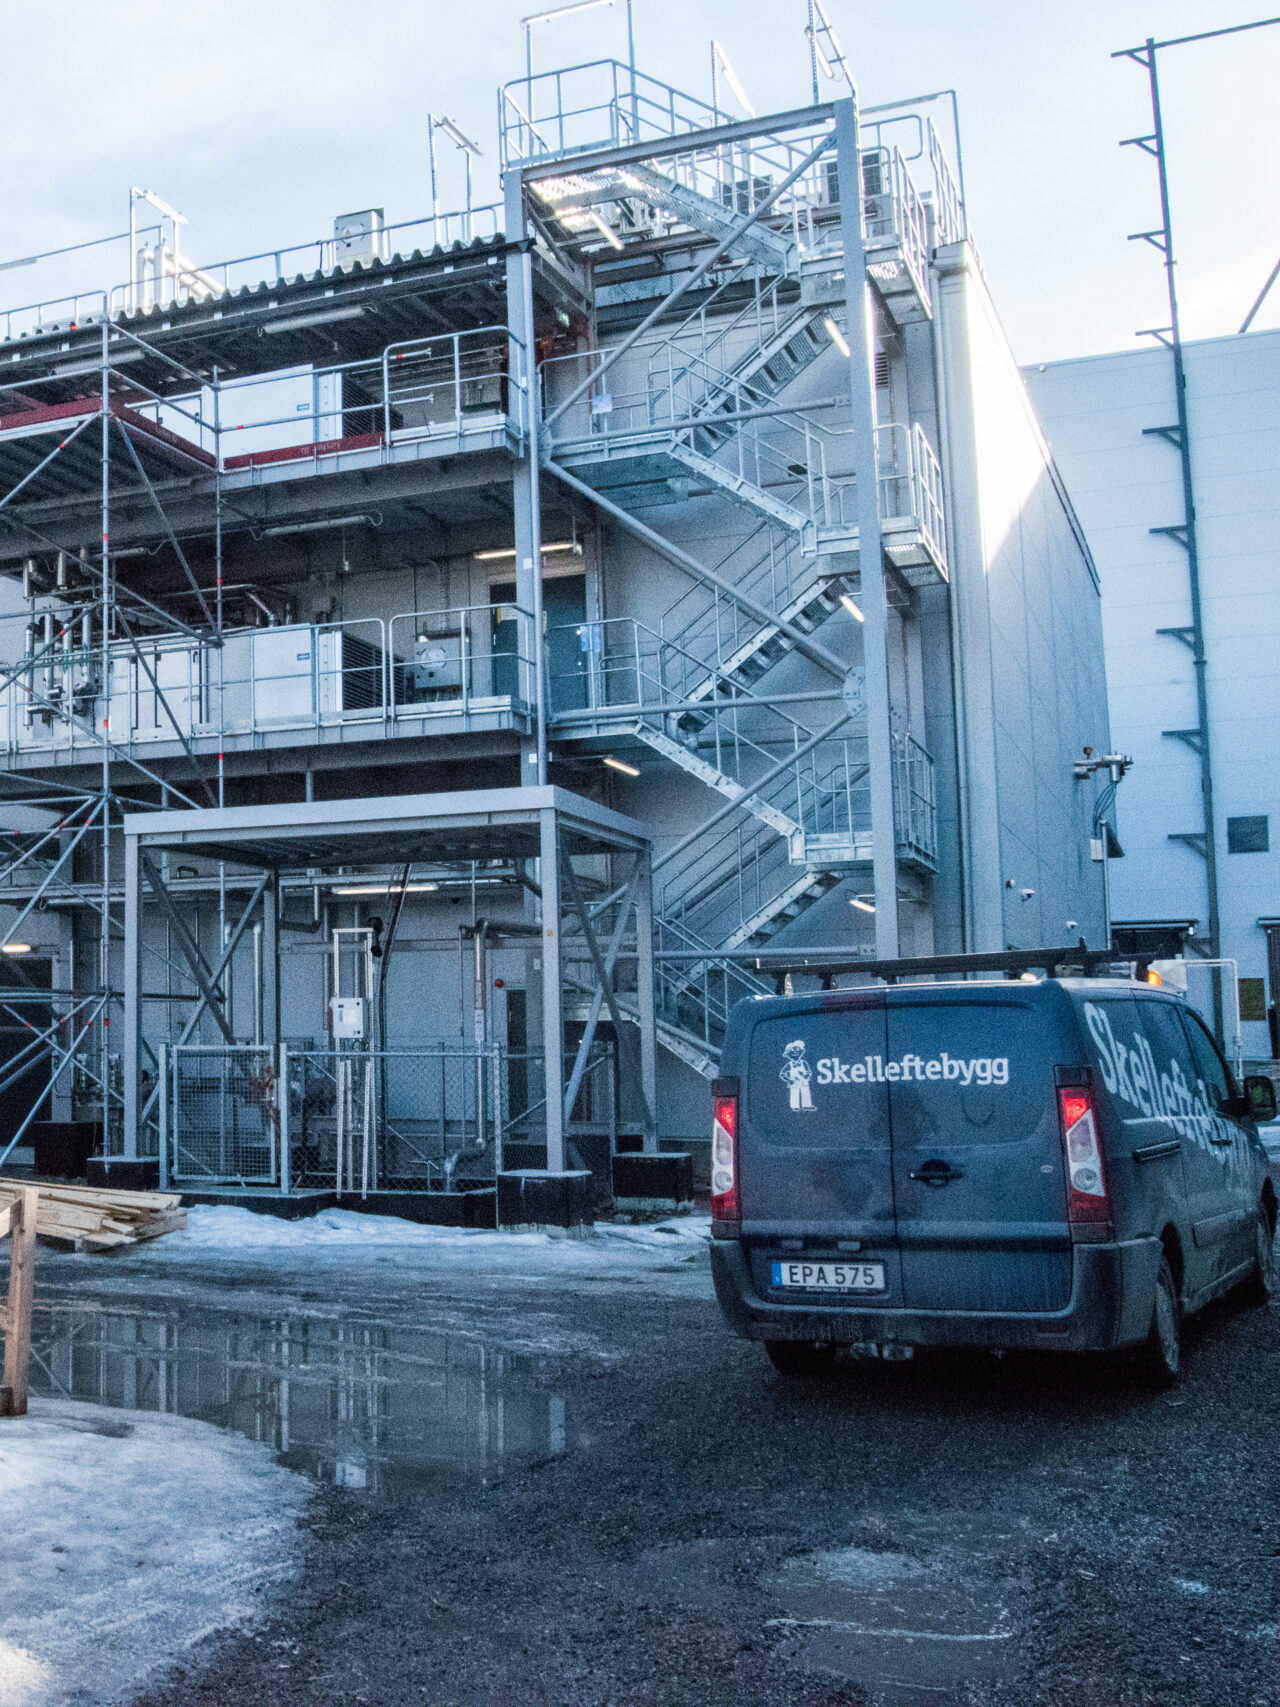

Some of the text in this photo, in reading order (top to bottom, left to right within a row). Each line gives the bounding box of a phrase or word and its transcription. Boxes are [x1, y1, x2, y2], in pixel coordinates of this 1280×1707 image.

[816, 1053, 1009, 1086] Skelleftebygg
[788, 1265, 875, 1286] EPA 575
